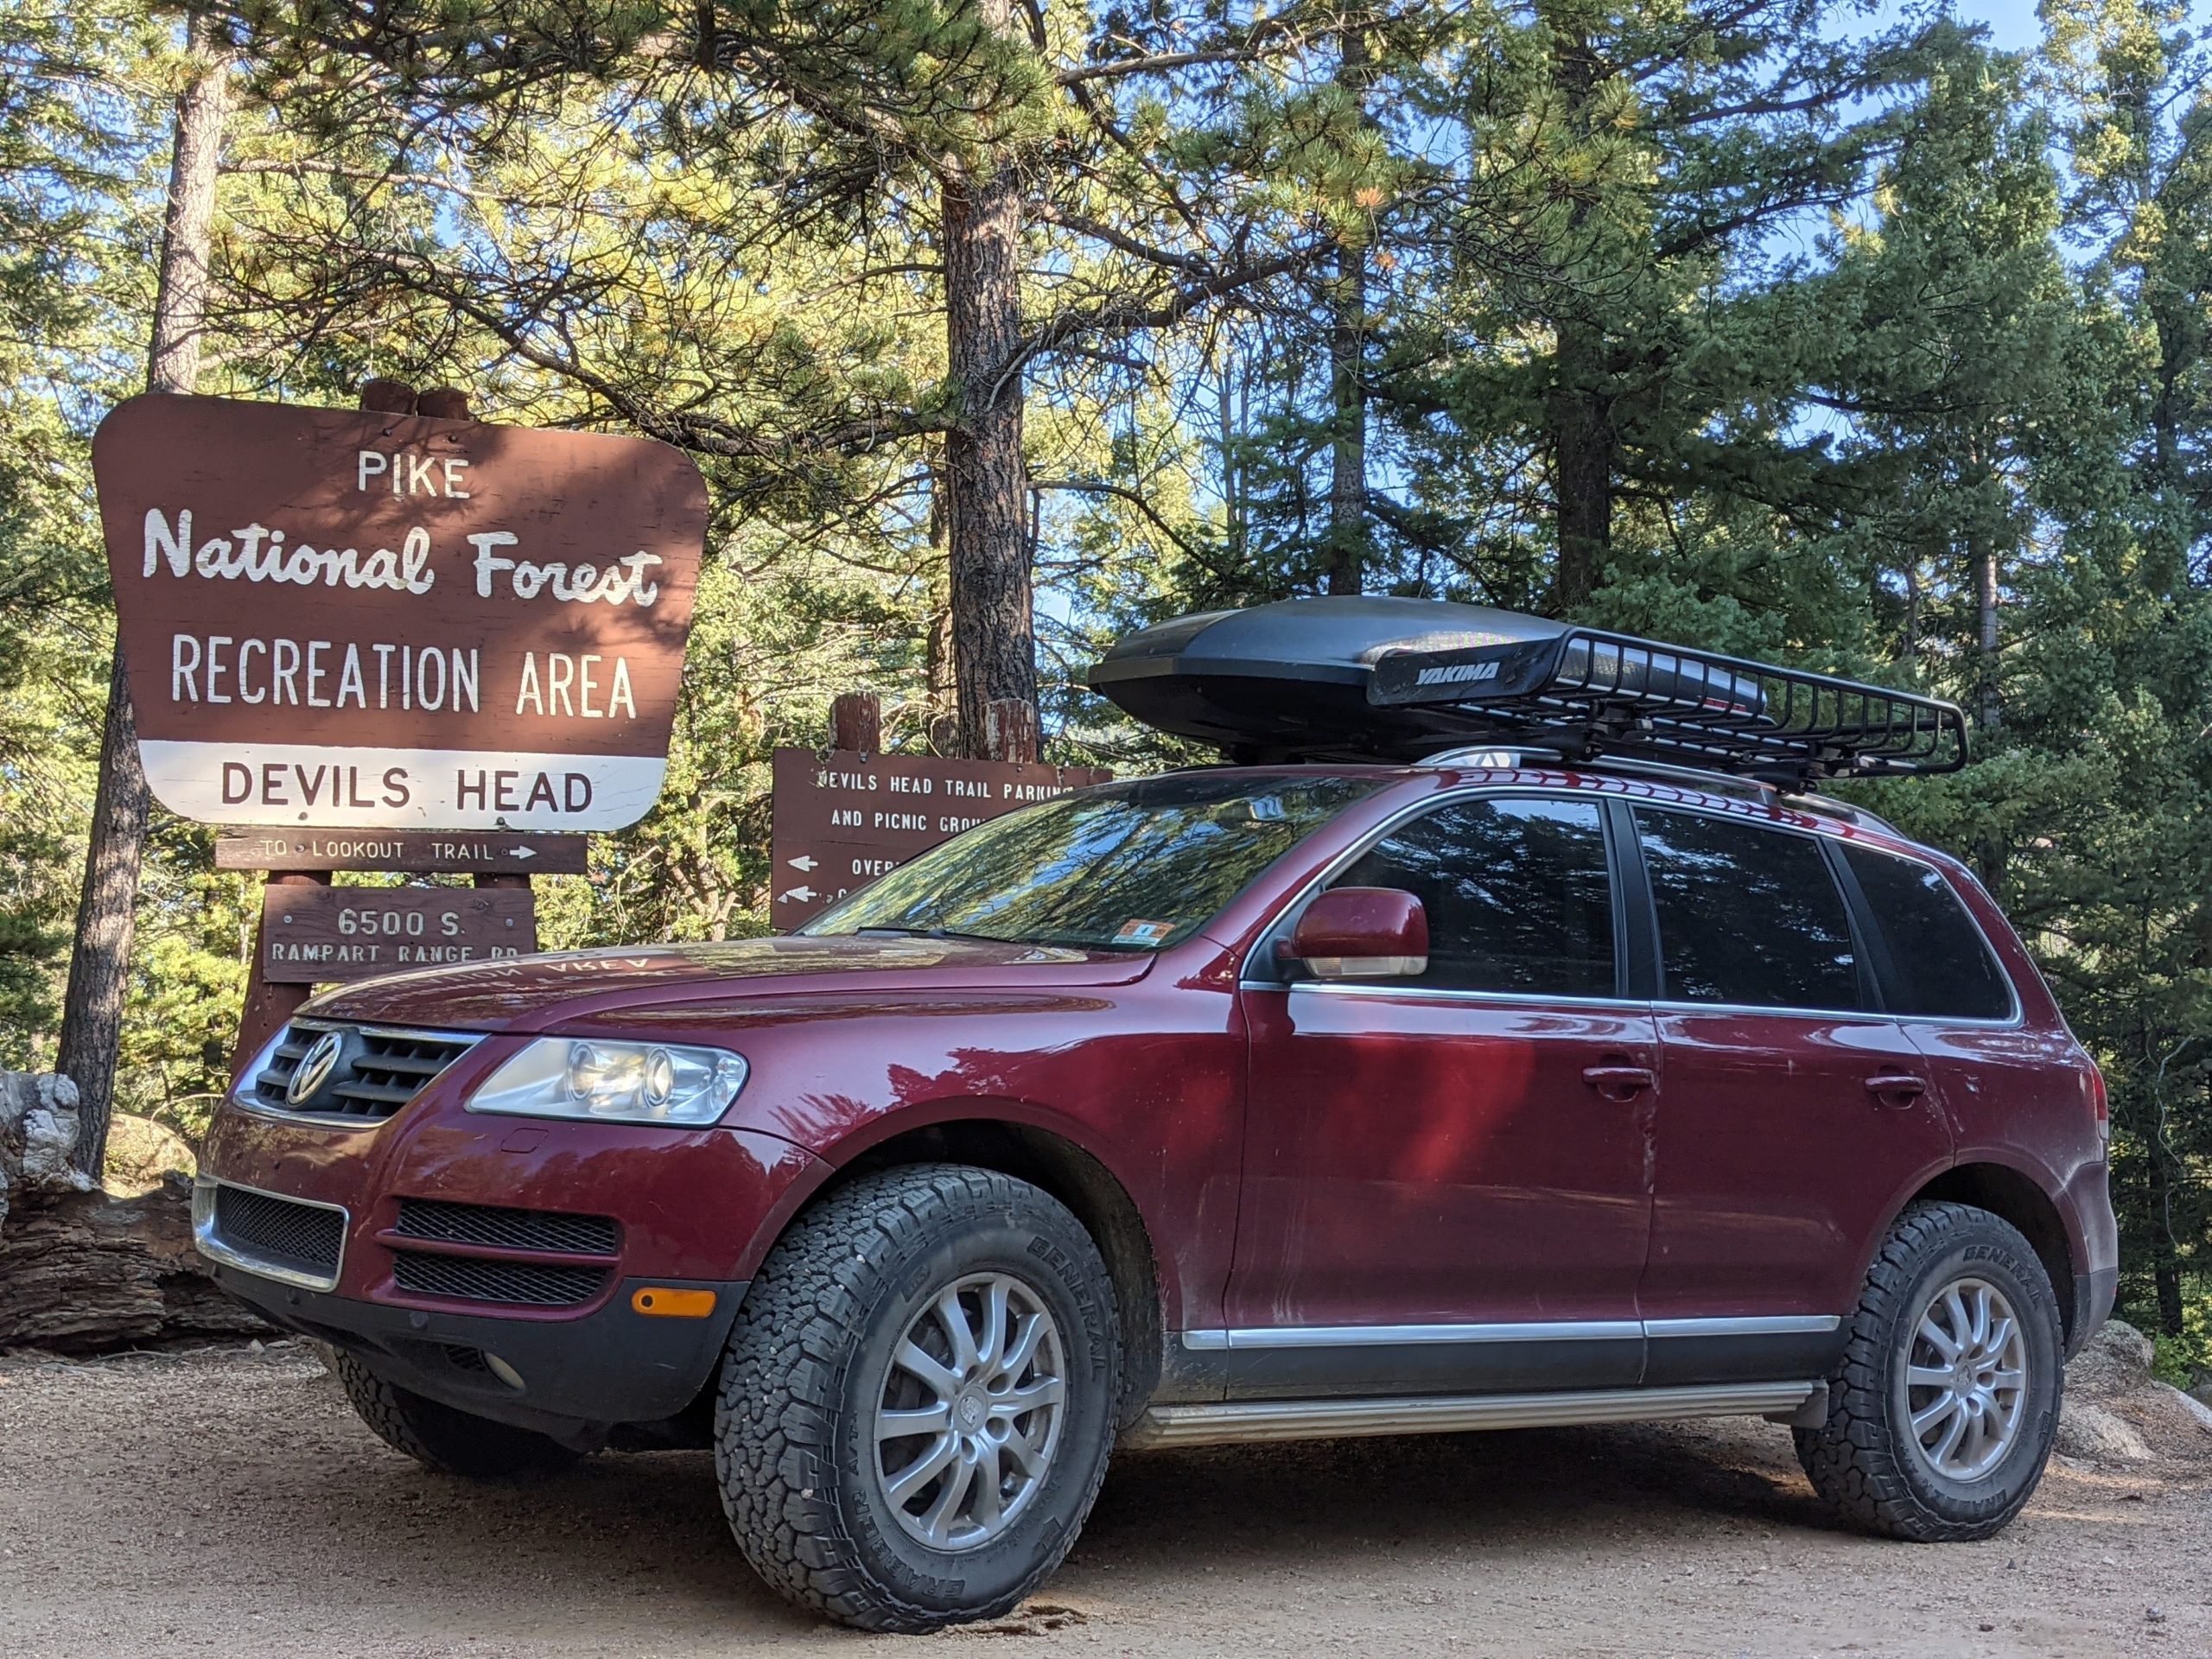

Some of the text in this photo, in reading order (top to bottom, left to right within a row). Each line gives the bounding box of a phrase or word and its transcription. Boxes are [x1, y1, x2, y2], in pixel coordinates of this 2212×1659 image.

[358, 451, 470, 499] PIKE
[143, 508, 663, 607] National Forest
[172, 634, 637, 719] RECREATION AREA
[1415, 662, 1500, 685] YAKIMA
[222, 762, 593, 813] DEVILS HEAD
[890, 776, 932, 793] HEAD
[945, 779, 991, 798] TRAIL
[831, 809, 862, 826] AND
[874, 812, 927, 831] PICNIC
[259, 840, 493, 861] TO LOOKOUT TRAIL
[852, 859, 899, 875] OVER
[338, 908, 423, 936] 6500
[271, 943, 380, 962] RAMPART
[397, 945, 473, 963] RANGE
[1962, 1245, 2039, 1311] GENERAL
[1027, 1236, 1107, 1380] GENERAL
